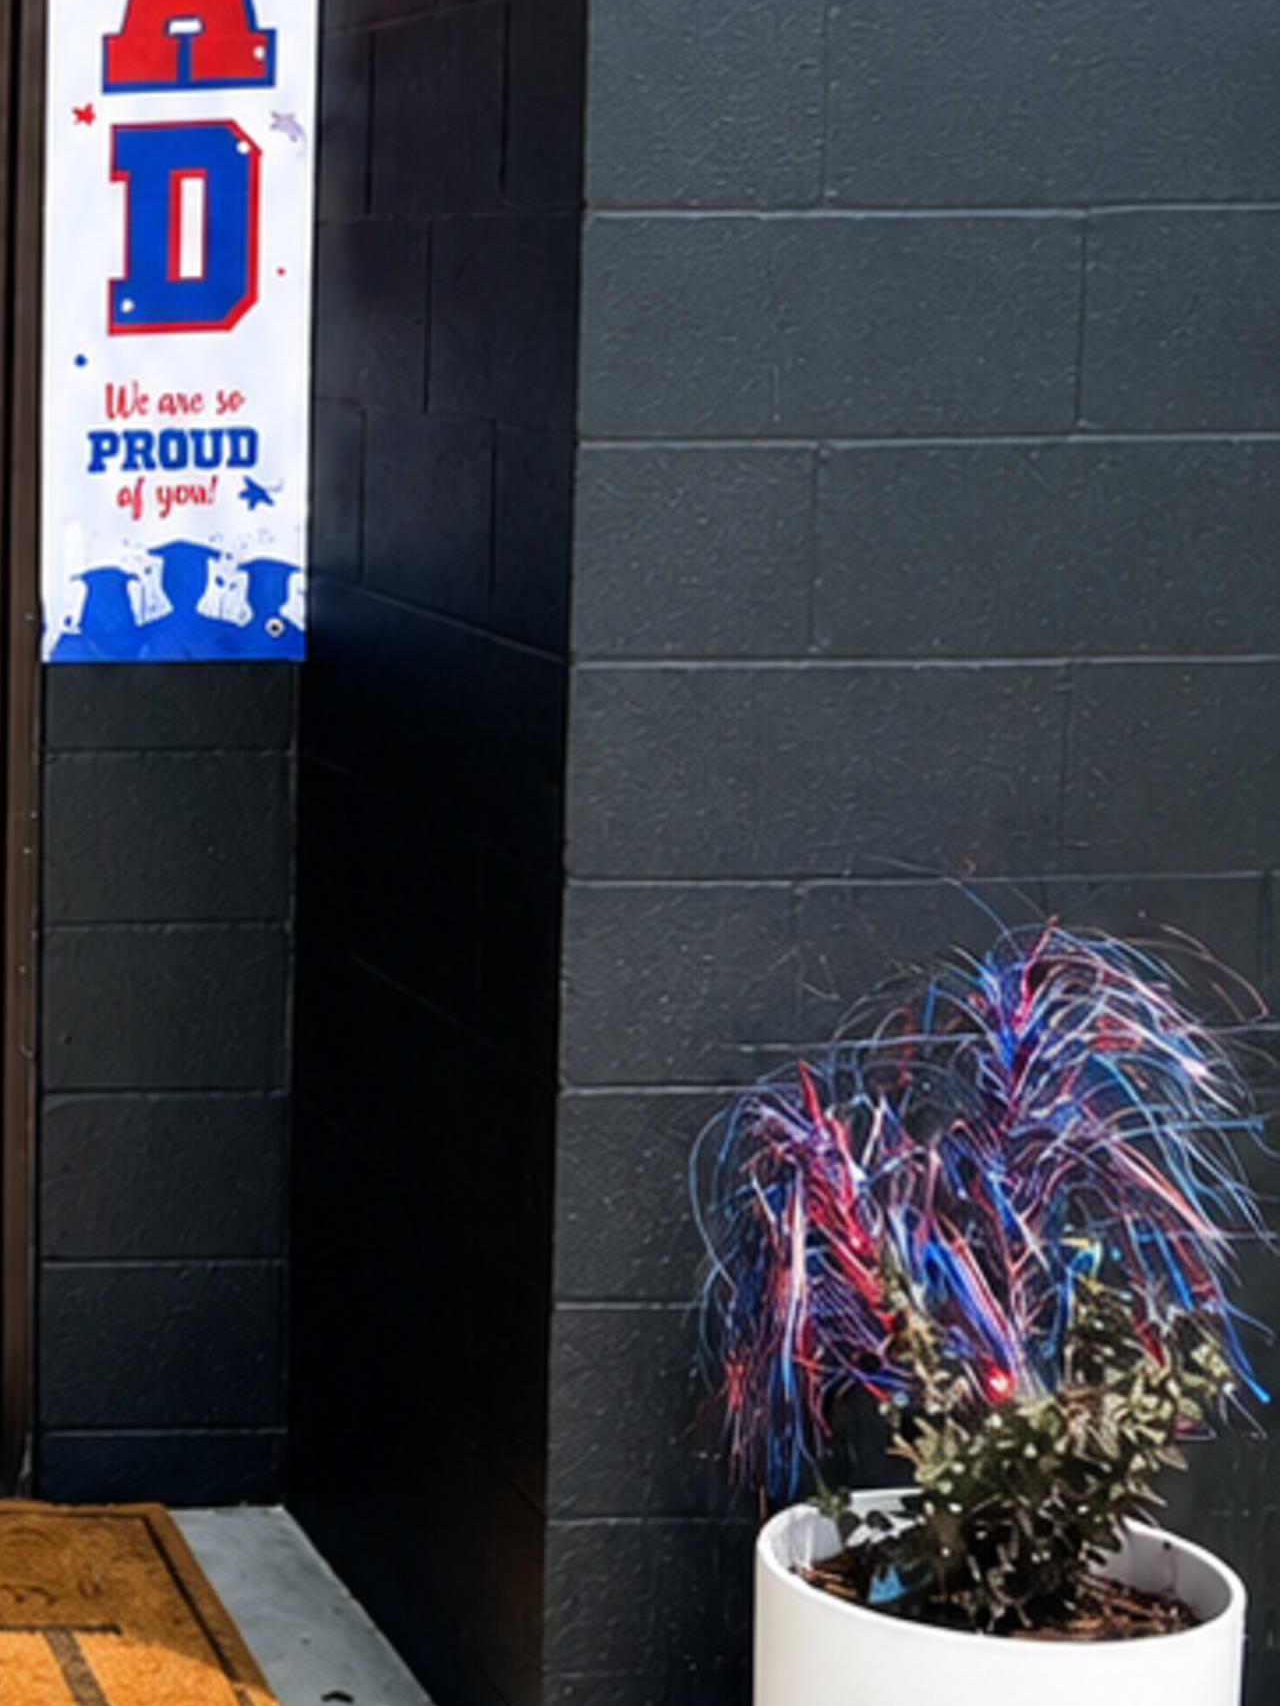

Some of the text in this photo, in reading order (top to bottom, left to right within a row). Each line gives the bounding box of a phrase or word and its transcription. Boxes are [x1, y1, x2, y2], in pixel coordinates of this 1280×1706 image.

[104, 380, 246, 420] We are so
[87, 426, 260, 474] PROUD
[115, 474, 218, 521] of you!
